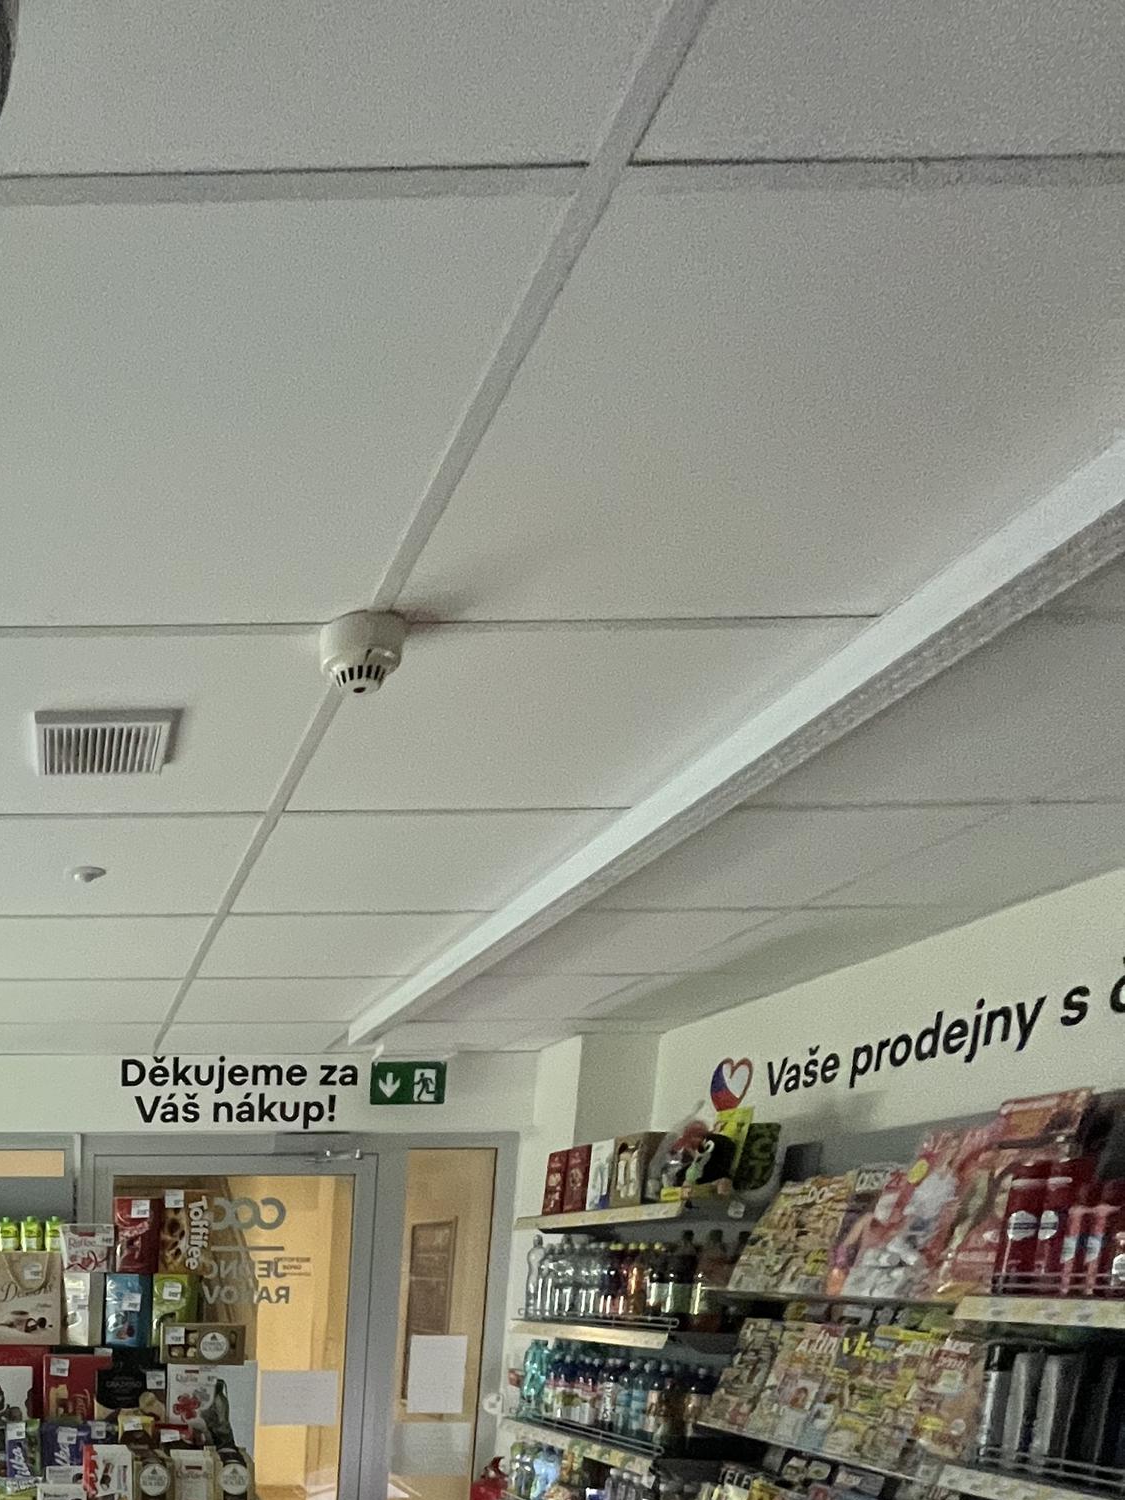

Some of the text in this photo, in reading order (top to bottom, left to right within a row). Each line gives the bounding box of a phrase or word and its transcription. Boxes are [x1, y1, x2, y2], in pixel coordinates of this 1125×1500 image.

[767, 1045, 840, 1096] Vaše
[849, 994, 1047, 1089] prodejny
[1060, 985, 1091, 1027] s
[121, 1055, 358, 1094] Děkujeme za
[134, 1092, 337, 1129] Váš nákup!
[185, 1194, 210, 1270] Toffifee
